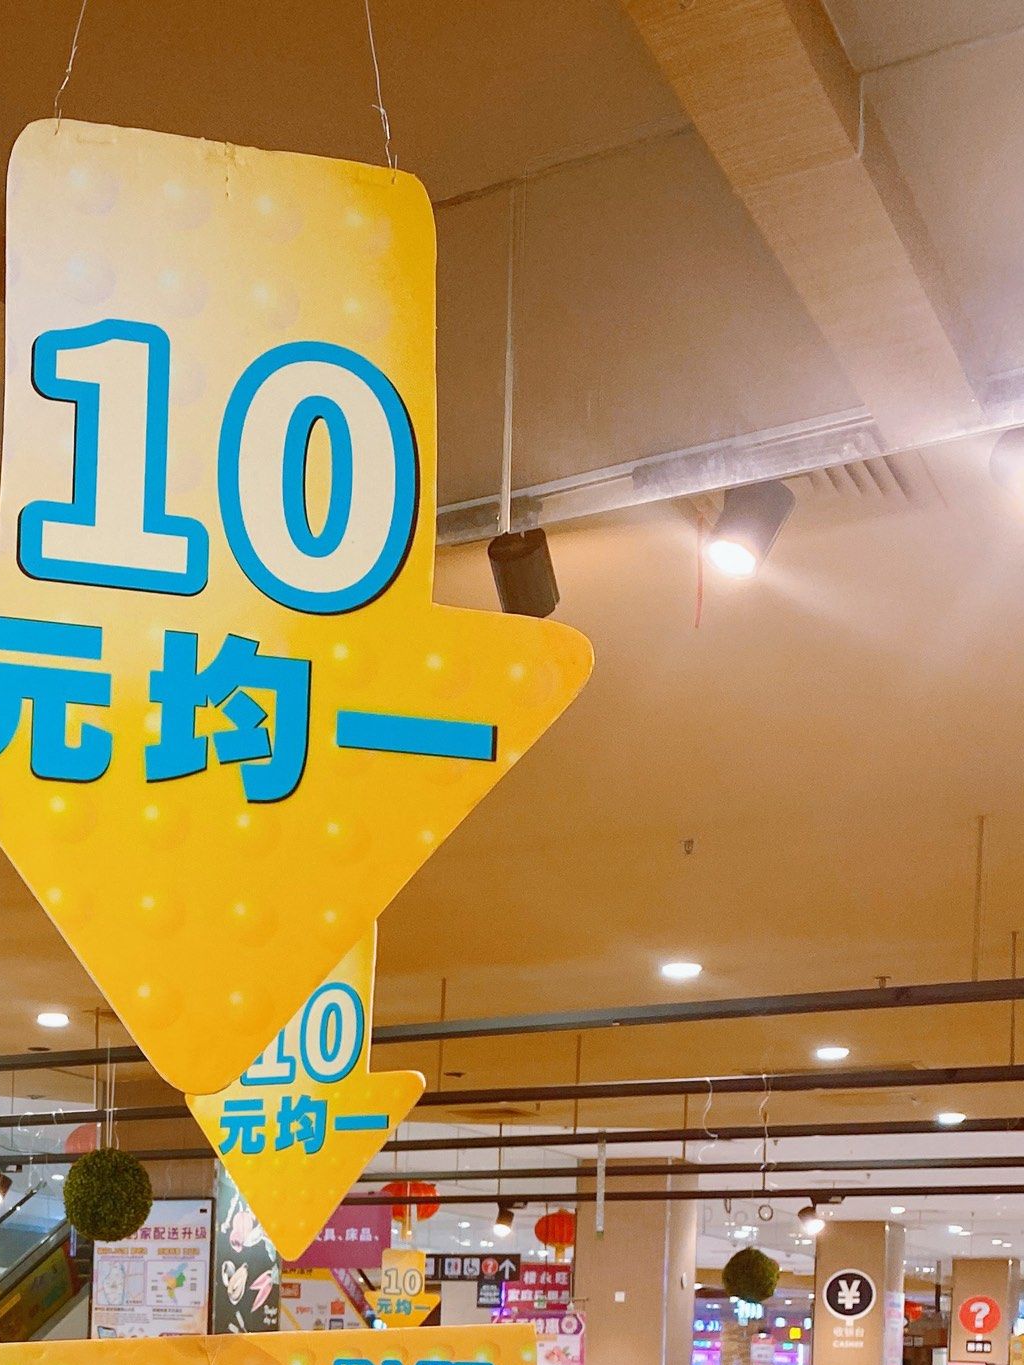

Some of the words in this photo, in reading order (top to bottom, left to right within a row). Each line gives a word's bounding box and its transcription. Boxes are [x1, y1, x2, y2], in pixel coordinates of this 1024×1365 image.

[18, 319, 420, 615] 10
[219, 1094, 390, 1158] 元均一
[384, 1267, 424, 1296] 10
[377, 1298, 431, 1316] 元均一
